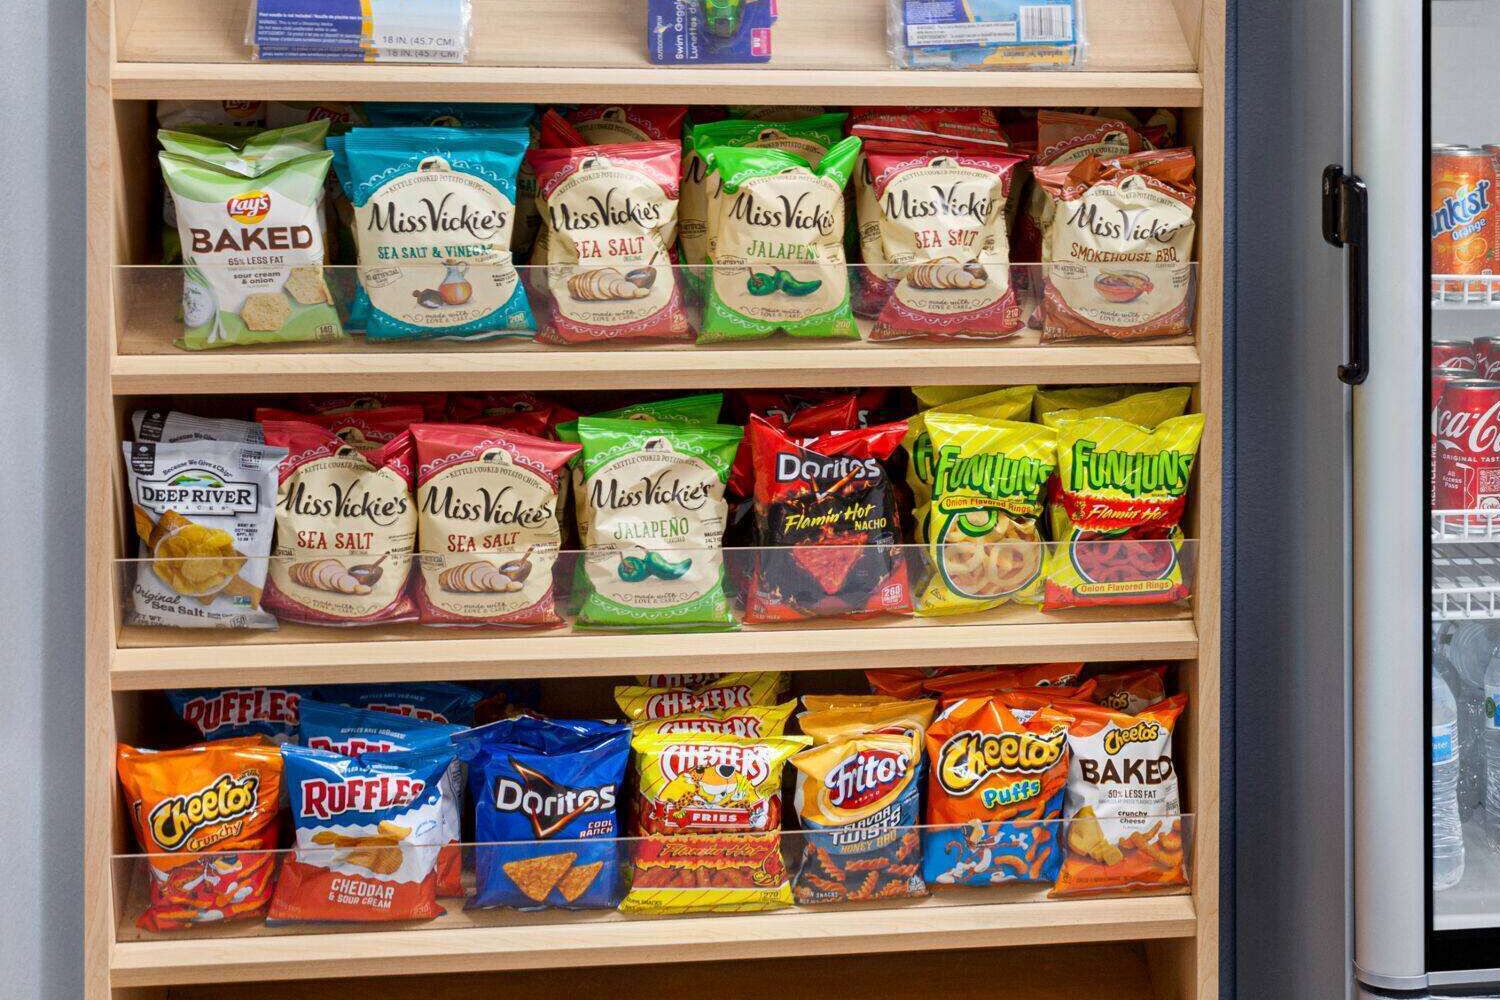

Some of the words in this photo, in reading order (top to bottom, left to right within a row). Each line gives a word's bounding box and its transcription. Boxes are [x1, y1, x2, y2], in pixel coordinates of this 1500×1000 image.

[383, 36, 394, 44] 18
[396, 36, 408, 44] IN.
[674, 34, 685, 60] Swim
[688, 17, 698, 59] Lunettes
[230, 193, 269, 217] Lay's
[190, 225, 313, 253] BAKED
[1452, 218, 1488, 240] orange
[228, 257, 246, 266] 65%
[247, 257, 268, 265] LESS
[270, 256, 284, 264] FAT
[378, 247, 398, 259] SEA
[402, 247, 427, 259] SALT
[432, 247, 442, 258] &
[1071, 242, 1151, 262] SMOKEHOUSE
[1156, 247, 1179, 262] BBQ
[163, 462, 187, 476] Because
[199, 460, 211, 468] Give
[612, 459, 636, 471] KETTLE
[636, 455, 660, 464] COOKED
[778, 454, 881, 480] Doritos
[1442, 454, 1478, 462] ORIGINAL
[450, 470, 475, 479] KETTLE
[500, 468, 521, 479] POTATO
[1072, 440, 1193, 498] FUNYUNS
[142, 486, 189, 503] DEEP
[193, 489, 251, 505] RIVER
[329, 478, 407, 527] Vickie's
[590, 478, 643, 509] Miss
[422, 485, 481, 520] Miss
[477, 485, 552, 528] Vickie's
[945, 498, 968, 508] Onion
[970, 498, 1007, 508] Flavored
[1008, 501, 1031, 513] Rings
[613, 517, 689, 540] JALAPEÑO
[784, 510, 842, 534] Flamin'
[844, 502, 876, 520] Hot
[854, 517, 887, 531] NACHO
[297, 530, 326, 549] SEA
[335, 533, 374, 549] SALT
[448, 535, 476, 552] SEA
[483, 532, 520, 549] SALT
[134, 584, 181, 605] Original
[1080, 583, 1106, 592] Onion
[1107, 582, 1144, 592] Flavored
[1146, 581, 1170, 590] Rings
[152, 602, 175, 612] Sea
[178, 606, 204, 618] Salt
[184, 689, 299, 732] RUFFLES
[1104, 722, 1160, 755] Cheetos
[1433, 741, 1448, 750] ater
[941, 731, 1067, 793] Cheetos
[1079, 756, 1173, 785] BAKED
[825, 755, 909, 805] Fritos
[496, 779, 615, 815] Doritos
[982, 780, 1041, 809] Puffs
[1125, 790, 1143, 798] LESS
[1144, 790, 1157, 798] FAT
[588, 820, 613, 829] COOL
[693, 813, 738, 823] FRIES
[830, 808, 901, 845] TWISTS
[842, 805, 892, 834] FLAVOR
[186, 820, 243, 851] Crunchy
[580, 826, 613, 839] RANCH
[841, 841, 872, 854] HONEY
[331, 878, 395, 899] CHEDDAR
[329, 893, 334, 901] &
[337, 894, 360, 904] SOUR
[362, 897, 392, 908] CREAM
